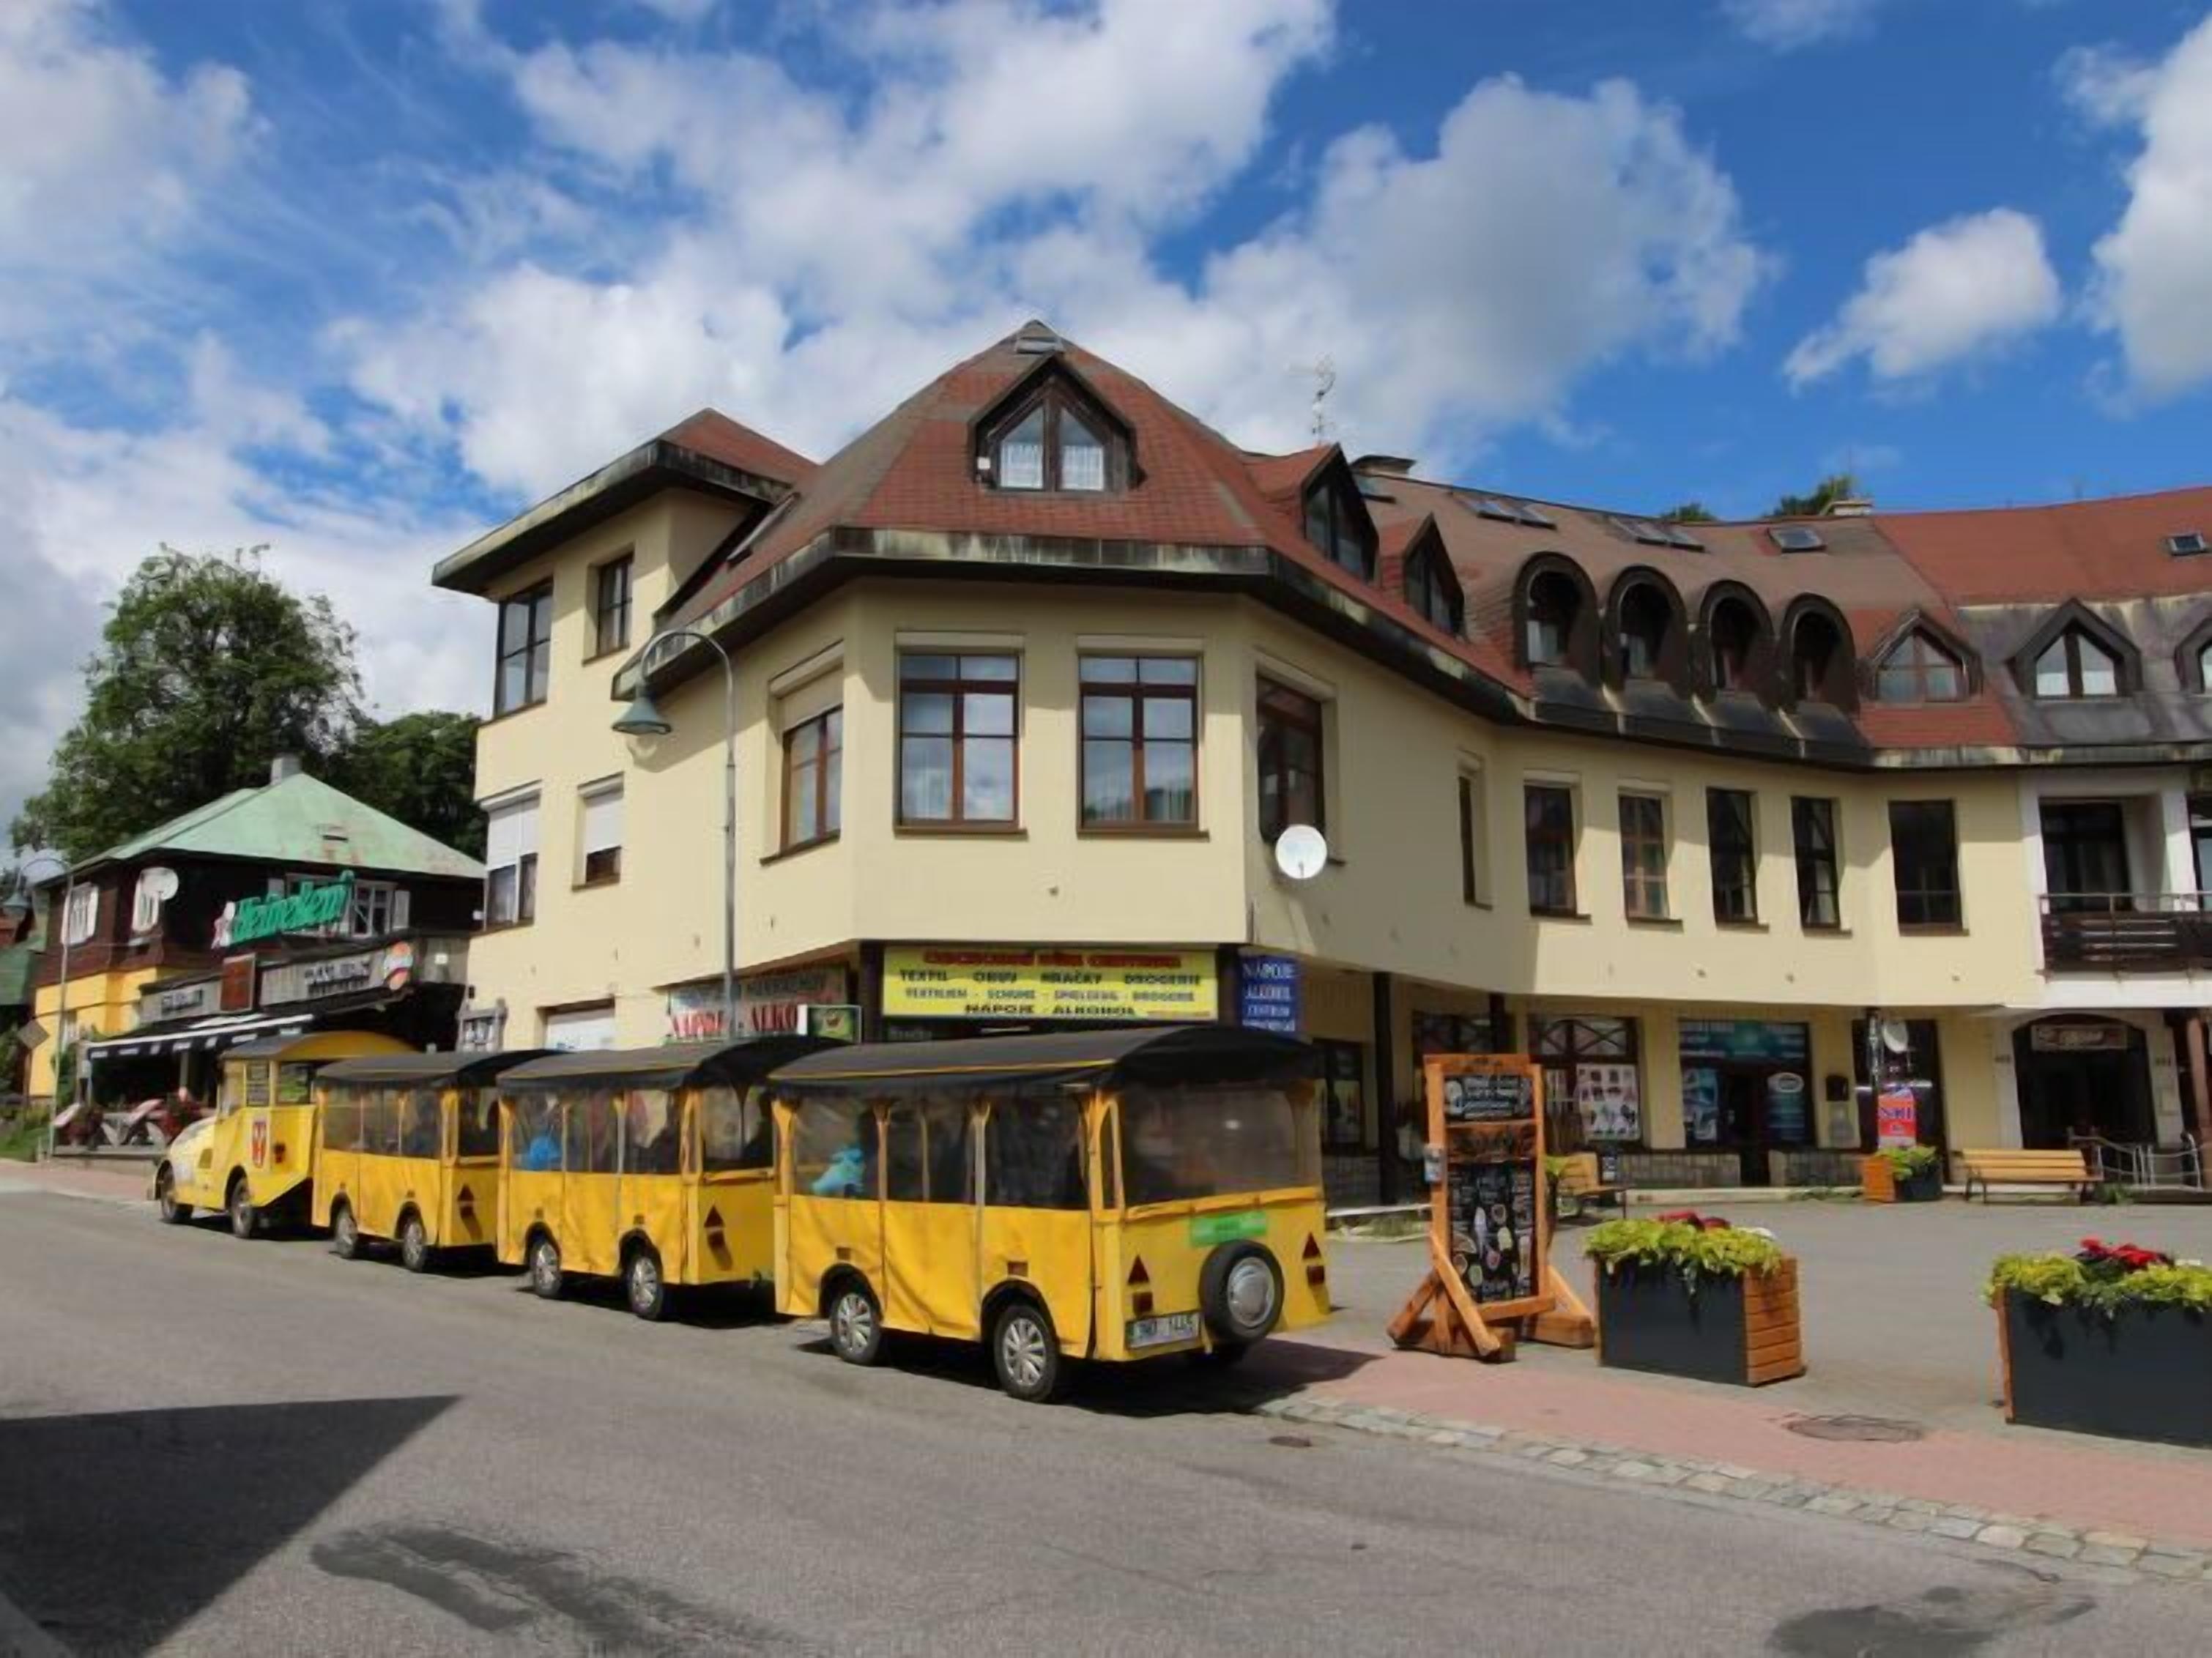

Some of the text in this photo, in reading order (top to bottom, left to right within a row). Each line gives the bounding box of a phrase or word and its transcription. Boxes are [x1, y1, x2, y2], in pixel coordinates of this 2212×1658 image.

[231, 880, 349, 943] Heineken
[899, 969, 1200, 985] TEXTIL OBUV HRAČKY DROGERIE
[965, 1003, 1136, 1015] NÁPOJE ALKOHOL
